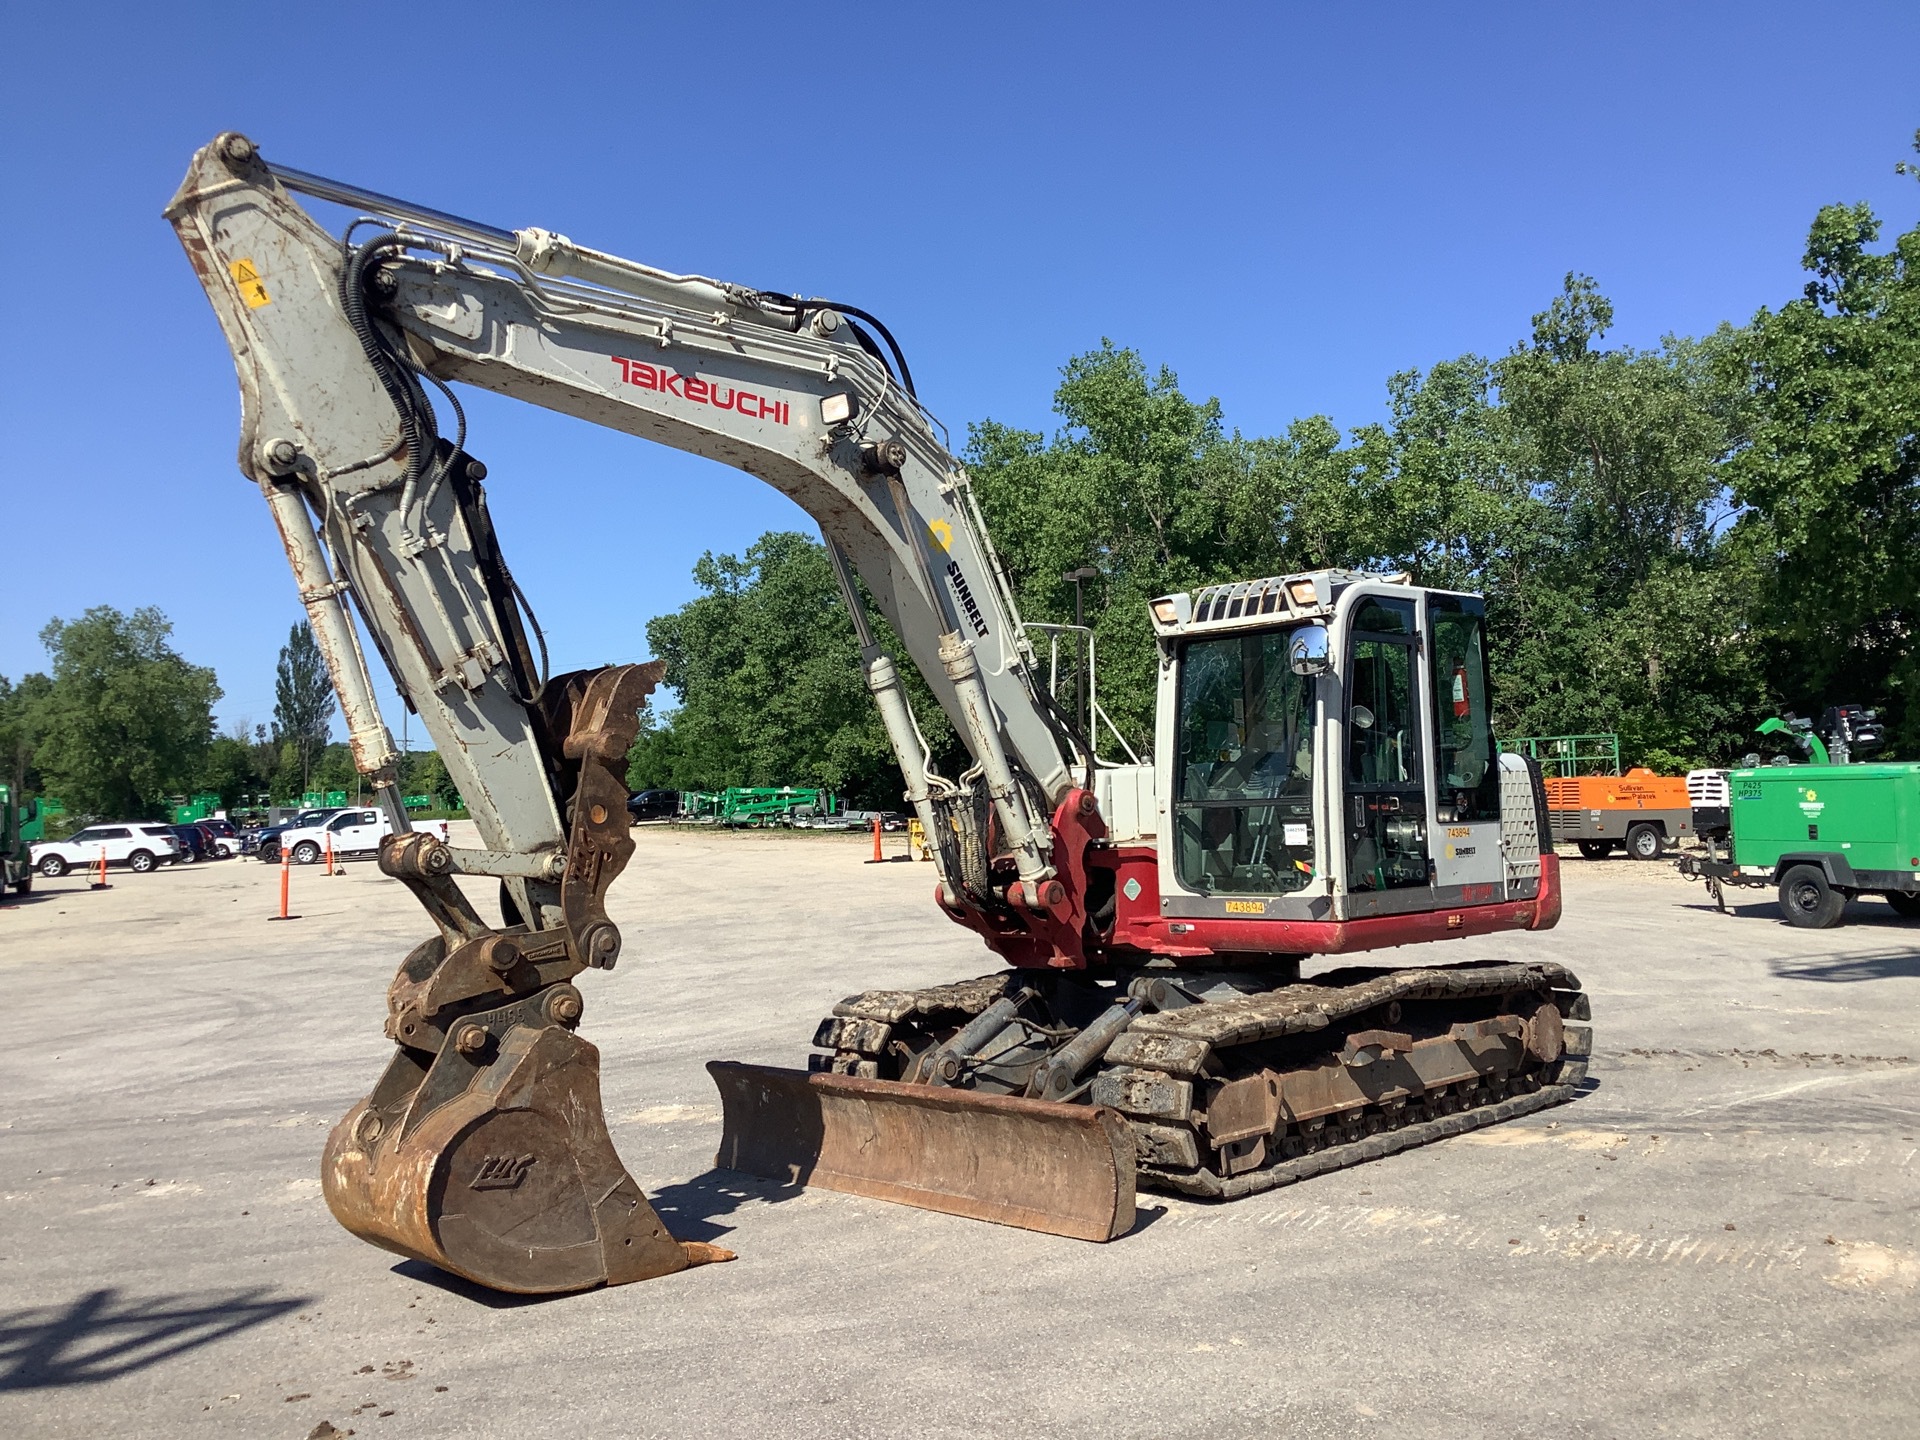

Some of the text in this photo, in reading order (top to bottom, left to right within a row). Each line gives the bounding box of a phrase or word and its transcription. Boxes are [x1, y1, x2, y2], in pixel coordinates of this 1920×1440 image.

[946, 560, 990, 638] SUNBELT
[950, 582, 973, 628] RENTALS
[1447, 827, 1470, 838] 743894
[1455, 846, 1476, 855] SUNBELT
[1226, 901, 1264, 913] 743894
